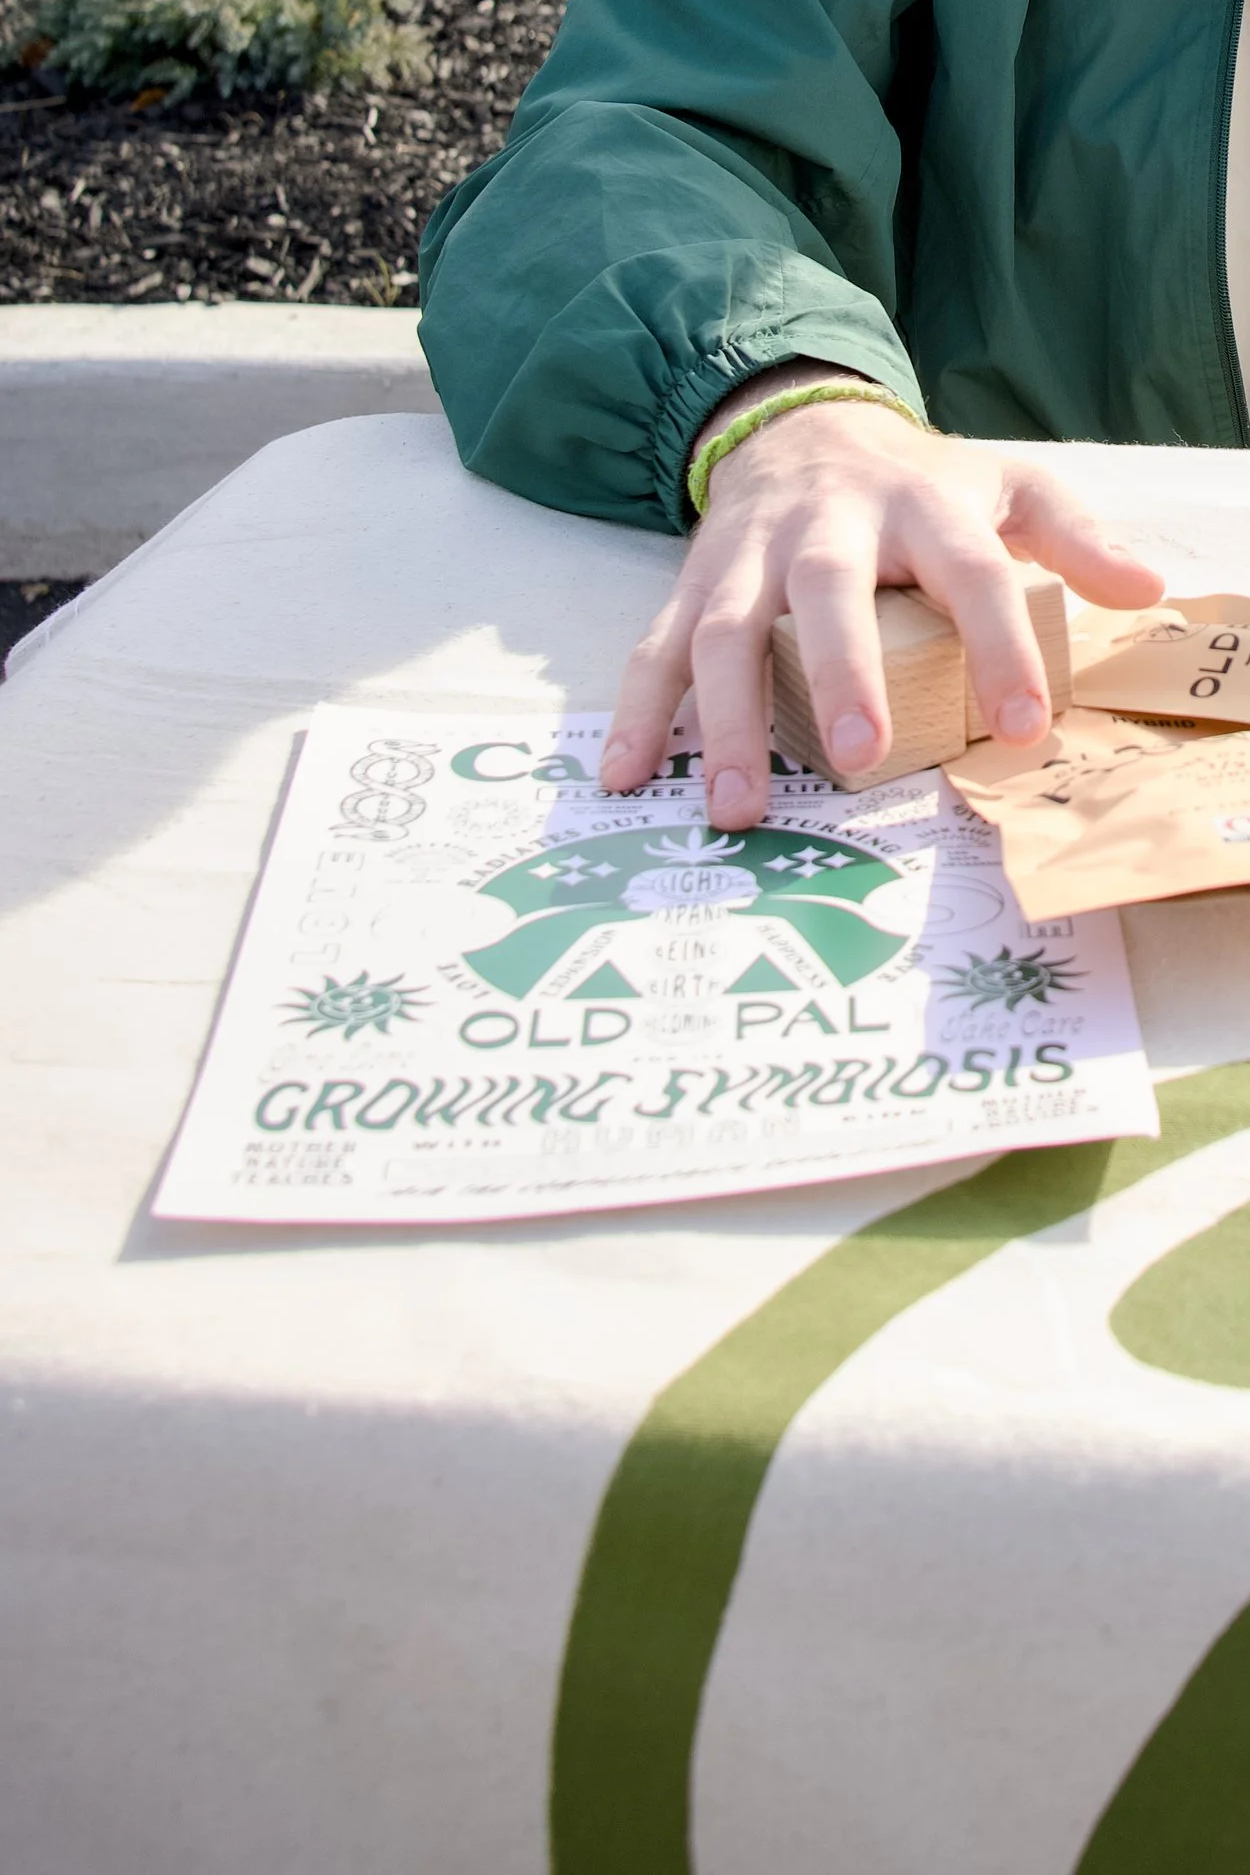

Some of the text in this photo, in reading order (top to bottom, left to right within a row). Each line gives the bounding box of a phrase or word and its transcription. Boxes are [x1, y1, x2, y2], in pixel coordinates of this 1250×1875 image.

[1189, 632, 1241, 699] OLD
[549, 728, 605, 739] THE
[1112, 714, 1197, 730] HYBRID
[556, 785, 687, 800] FLOWER
[455, 827, 581, 889] RADIATES
[591, 813, 655, 832] OUT
[760, 812, 902, 855] ETURNING
[656, 869, 727, 895] LIGHT
[458, 996, 891, 1050] OLD PAL
[1019, 1009, 1086, 1038] Care
[254, 1069, 633, 1132] GROWING
[636, 1043, 1075, 1119] SYMBIOSIS
